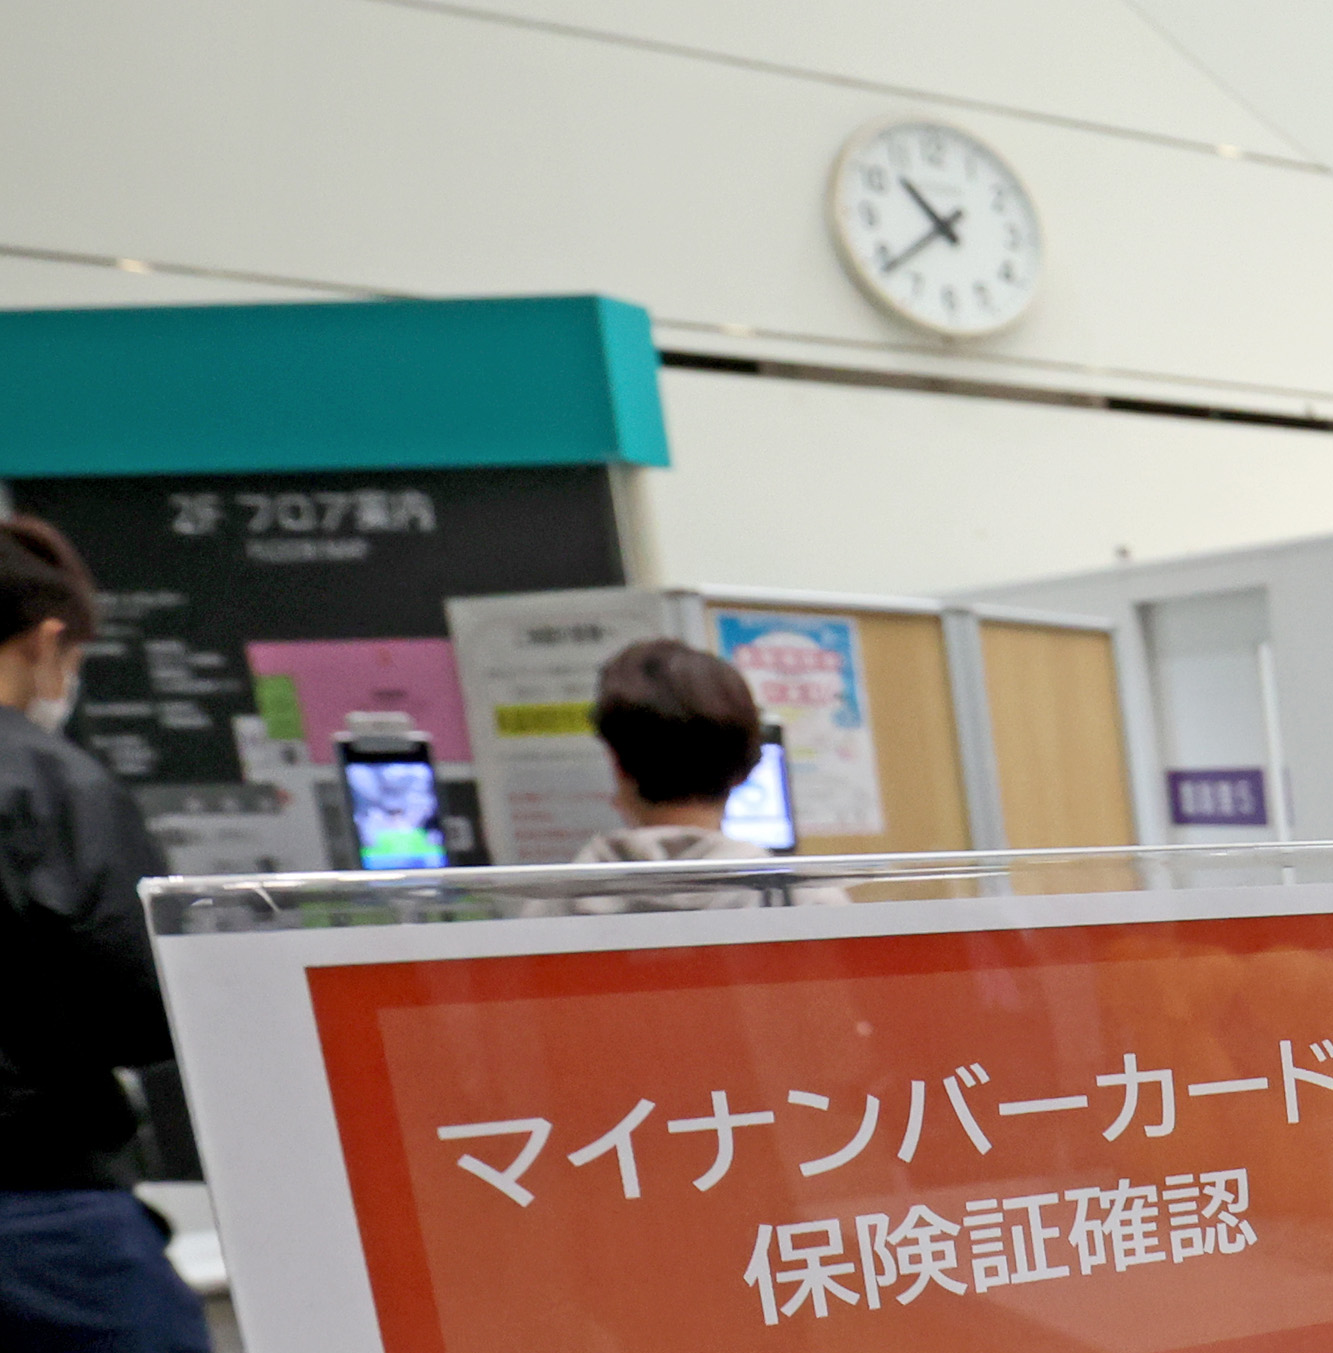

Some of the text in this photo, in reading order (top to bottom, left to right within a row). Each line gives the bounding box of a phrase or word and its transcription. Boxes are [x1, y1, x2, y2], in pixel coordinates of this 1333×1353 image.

[744, 1167, 1258, 1327] 保険証確認
